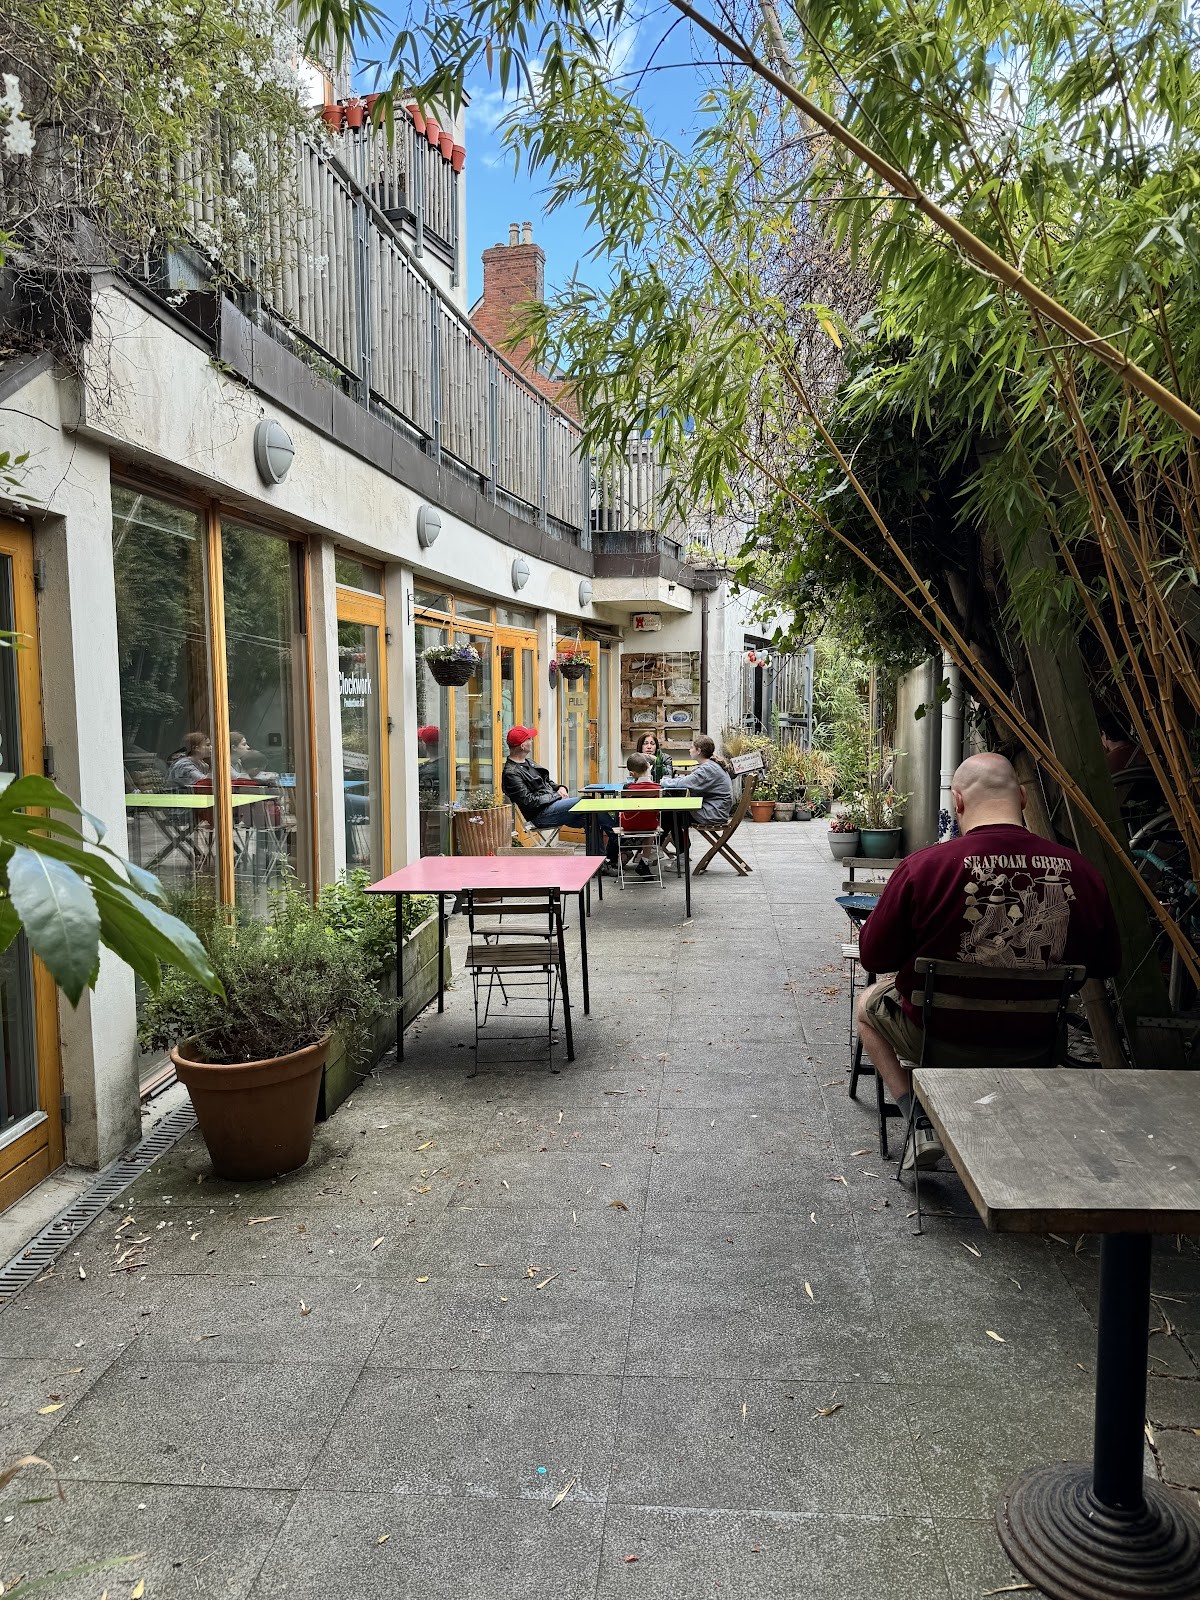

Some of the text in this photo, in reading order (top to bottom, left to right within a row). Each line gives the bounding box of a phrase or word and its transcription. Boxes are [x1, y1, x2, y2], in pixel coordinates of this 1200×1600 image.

[339, 671, 372, 695] Clockwork
[568, 697, 584, 706] PULL
[963, 854, 1072, 872] SEAFOAM GREEN
